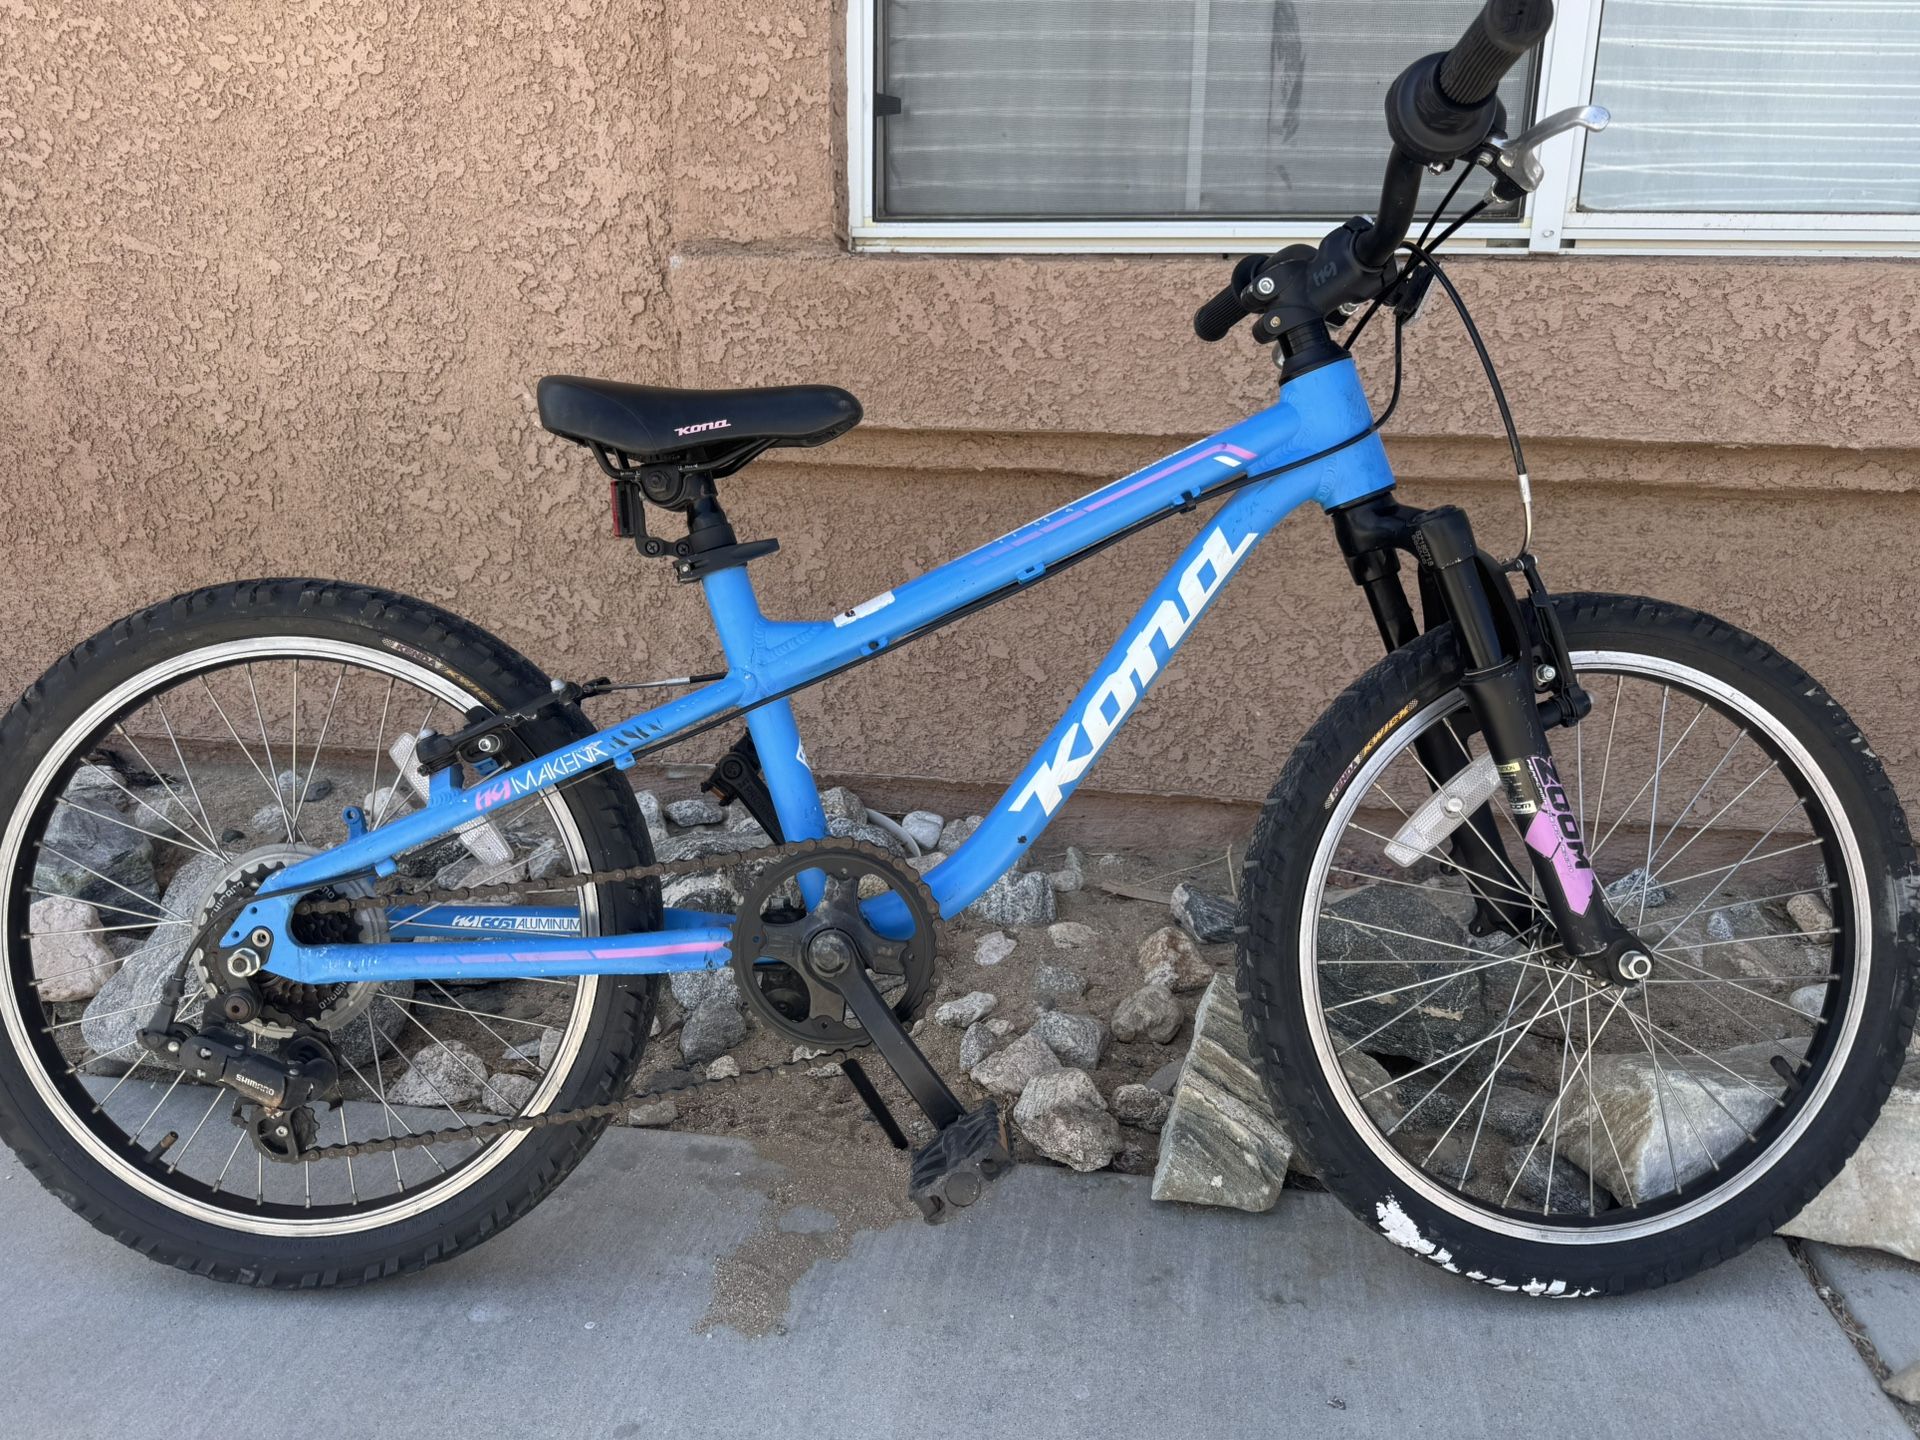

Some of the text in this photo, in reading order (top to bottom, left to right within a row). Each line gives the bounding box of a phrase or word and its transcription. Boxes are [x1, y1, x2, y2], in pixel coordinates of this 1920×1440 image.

[512, 740, 609, 794] MAKENA
[1530, 756, 1592, 869] ZOOM
[516, 918, 580, 931] ALUMINUM
[235, 1073, 275, 1096] SHIMANO
